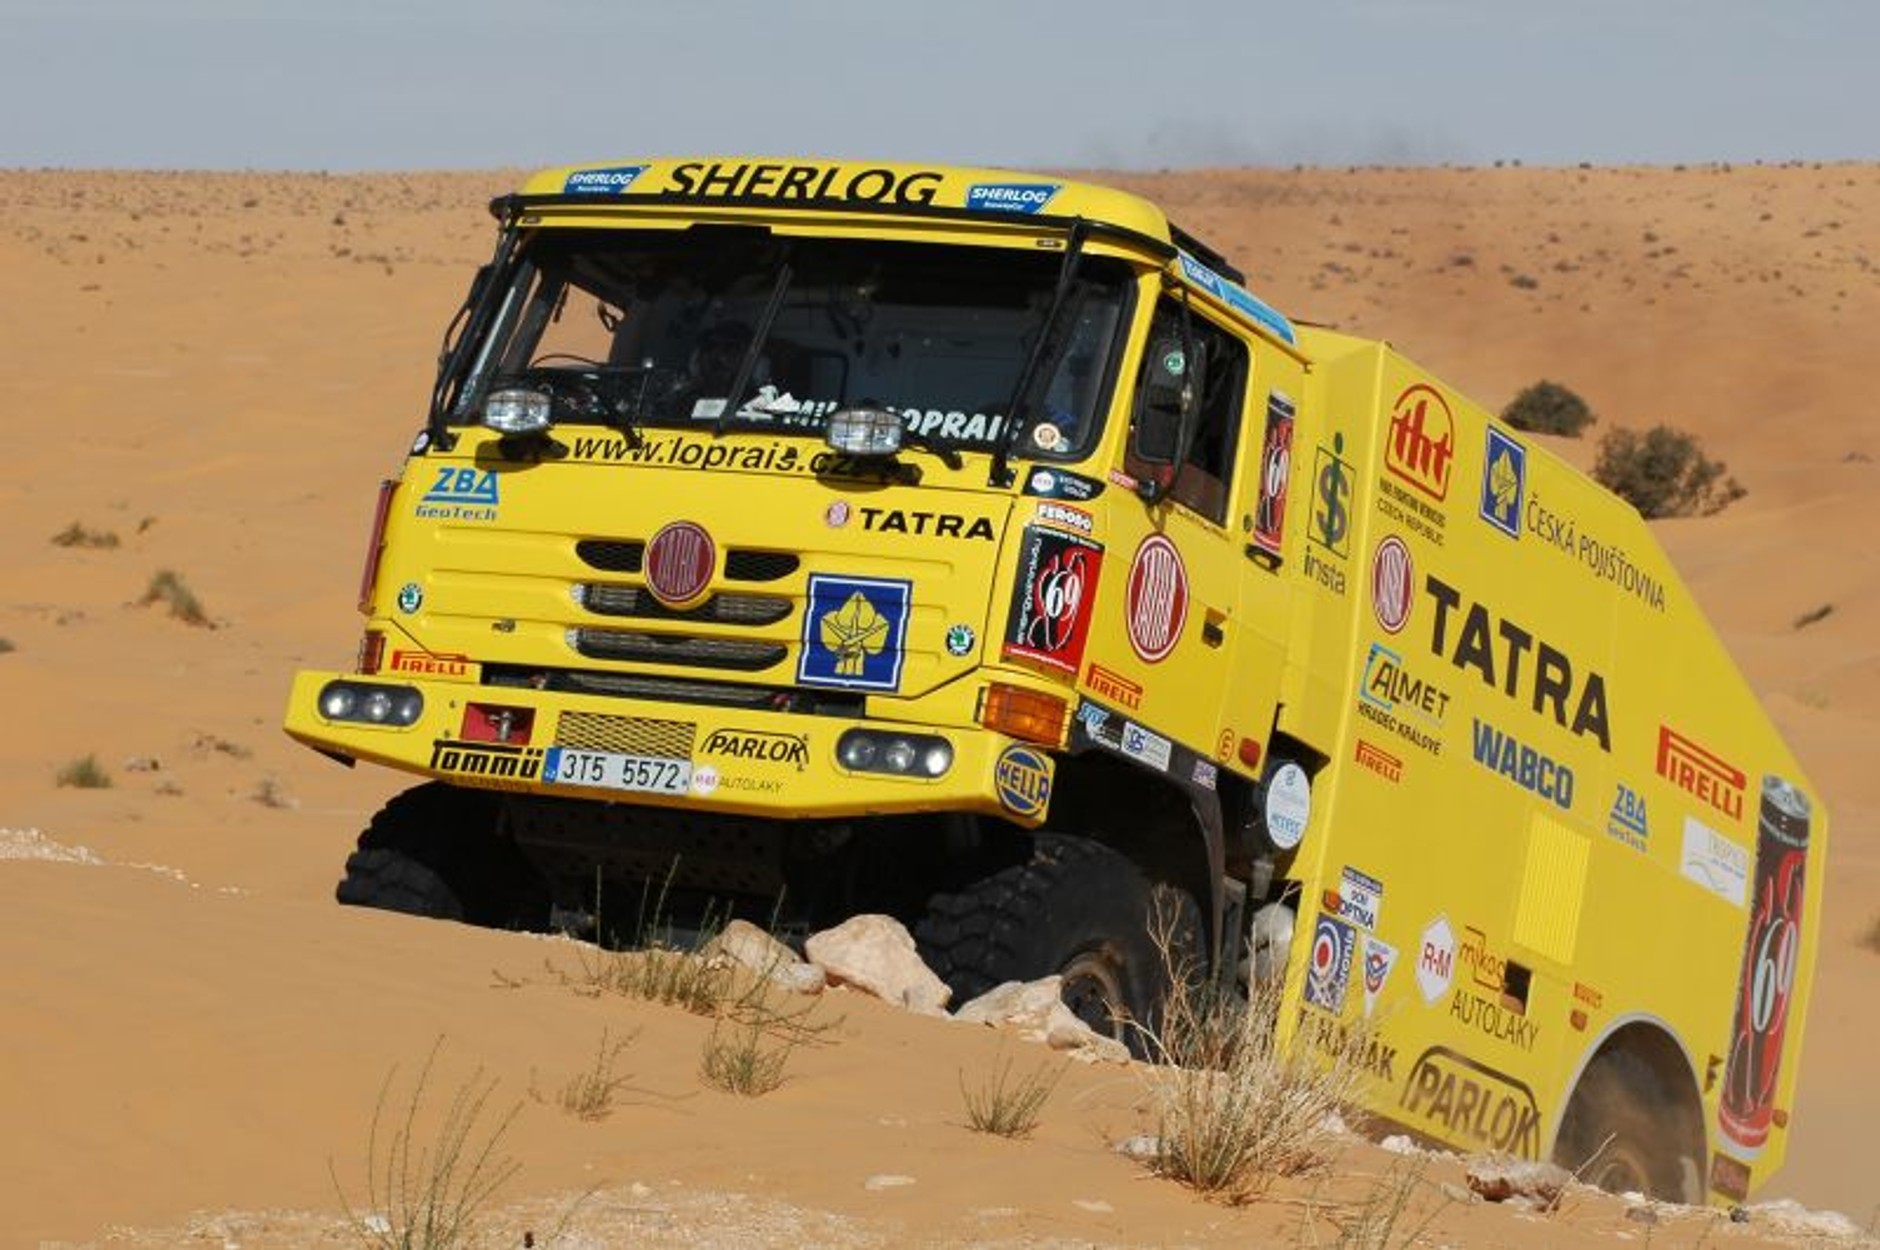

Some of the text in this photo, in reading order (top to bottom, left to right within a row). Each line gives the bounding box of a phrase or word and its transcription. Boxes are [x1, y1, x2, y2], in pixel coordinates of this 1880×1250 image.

[569, 172, 634, 185] SHERLOG
[661, 162, 943, 206] SHERLOG
[971, 187, 1048, 203] SHERLOG
[888, 406, 1023, 441] OPRAI
[573, 437, 850, 477] www.loprais.cz
[861, 507, 995, 541] TATRA
[1527, 491, 1575, 557] ČESKÁ
[1304, 545, 1346, 597] insta
[1045, 569, 1082, 621] 69
[389, 649, 467, 676] PIRELLI
[1426, 574, 1611, 753] TATRA
[1087, 661, 1143, 710] PIRELLI
[1371, 660, 1450, 719] ALMET
[707, 735, 804, 762] PARLOK
[1355, 739, 1402, 783] PIRELLI
[1473, 717, 1573, 810] WABCO
[563, 754, 678, 790] 3T5 5572
[720, 776, 784, 793] AUTOLAKY
[998, 761, 1050, 801] HELLA
[1656, 725, 1747, 822] PIRELLI
[1753, 917, 1797, 1032] 69
[1450, 989, 1539, 1052] AUTOLAKY
[1411, 1061, 1539, 1161] PARLOK
